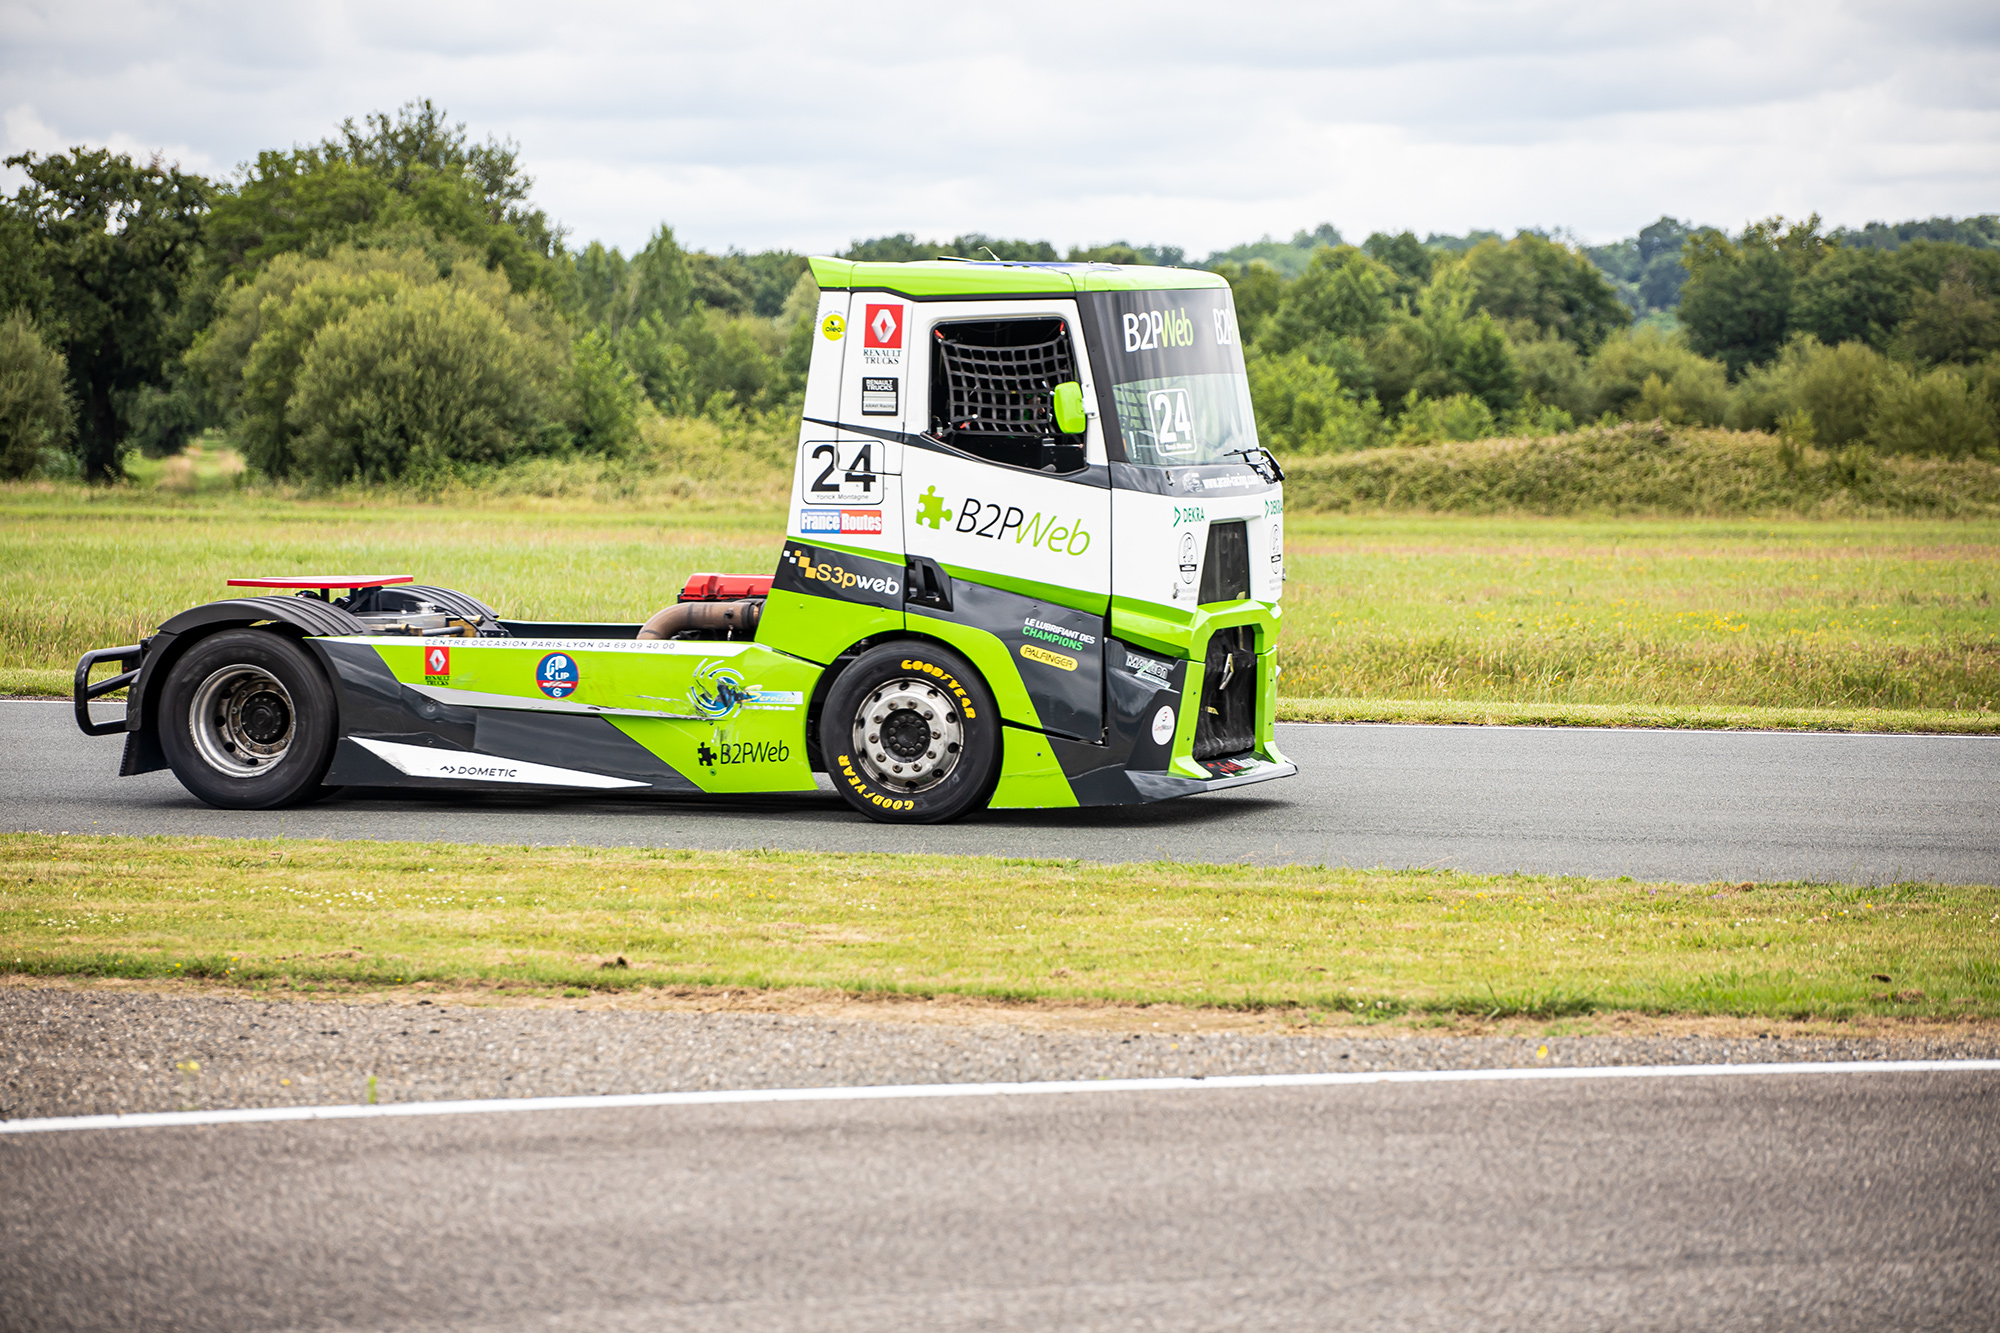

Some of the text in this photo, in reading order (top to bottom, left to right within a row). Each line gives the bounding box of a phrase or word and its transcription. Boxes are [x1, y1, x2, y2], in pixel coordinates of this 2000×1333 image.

[1123, 307, 1194, 352] B2PWeb
[863, 349, 902, 357] RENAULT
[1154, 392, 1193, 444] 24
[811, 444, 876, 492] 24
[801, 512, 882, 531] France Routes
[955, 498, 1091, 556] B2PWeb
[1183, 507, 1206, 523] DEKRA
[1022, 625, 1084, 652] CHAMPIONS
[1025, 617, 1096, 645] LE LUBRIFIANT DES
[1023, 646, 1074, 668] PALFINGER
[901, 659, 976, 719] GOODYEAR
[720, 740, 790, 765] B2PWeb
[458, 766, 517, 778] DOMETIC
[837, 755, 914, 811] GOODYEAR
